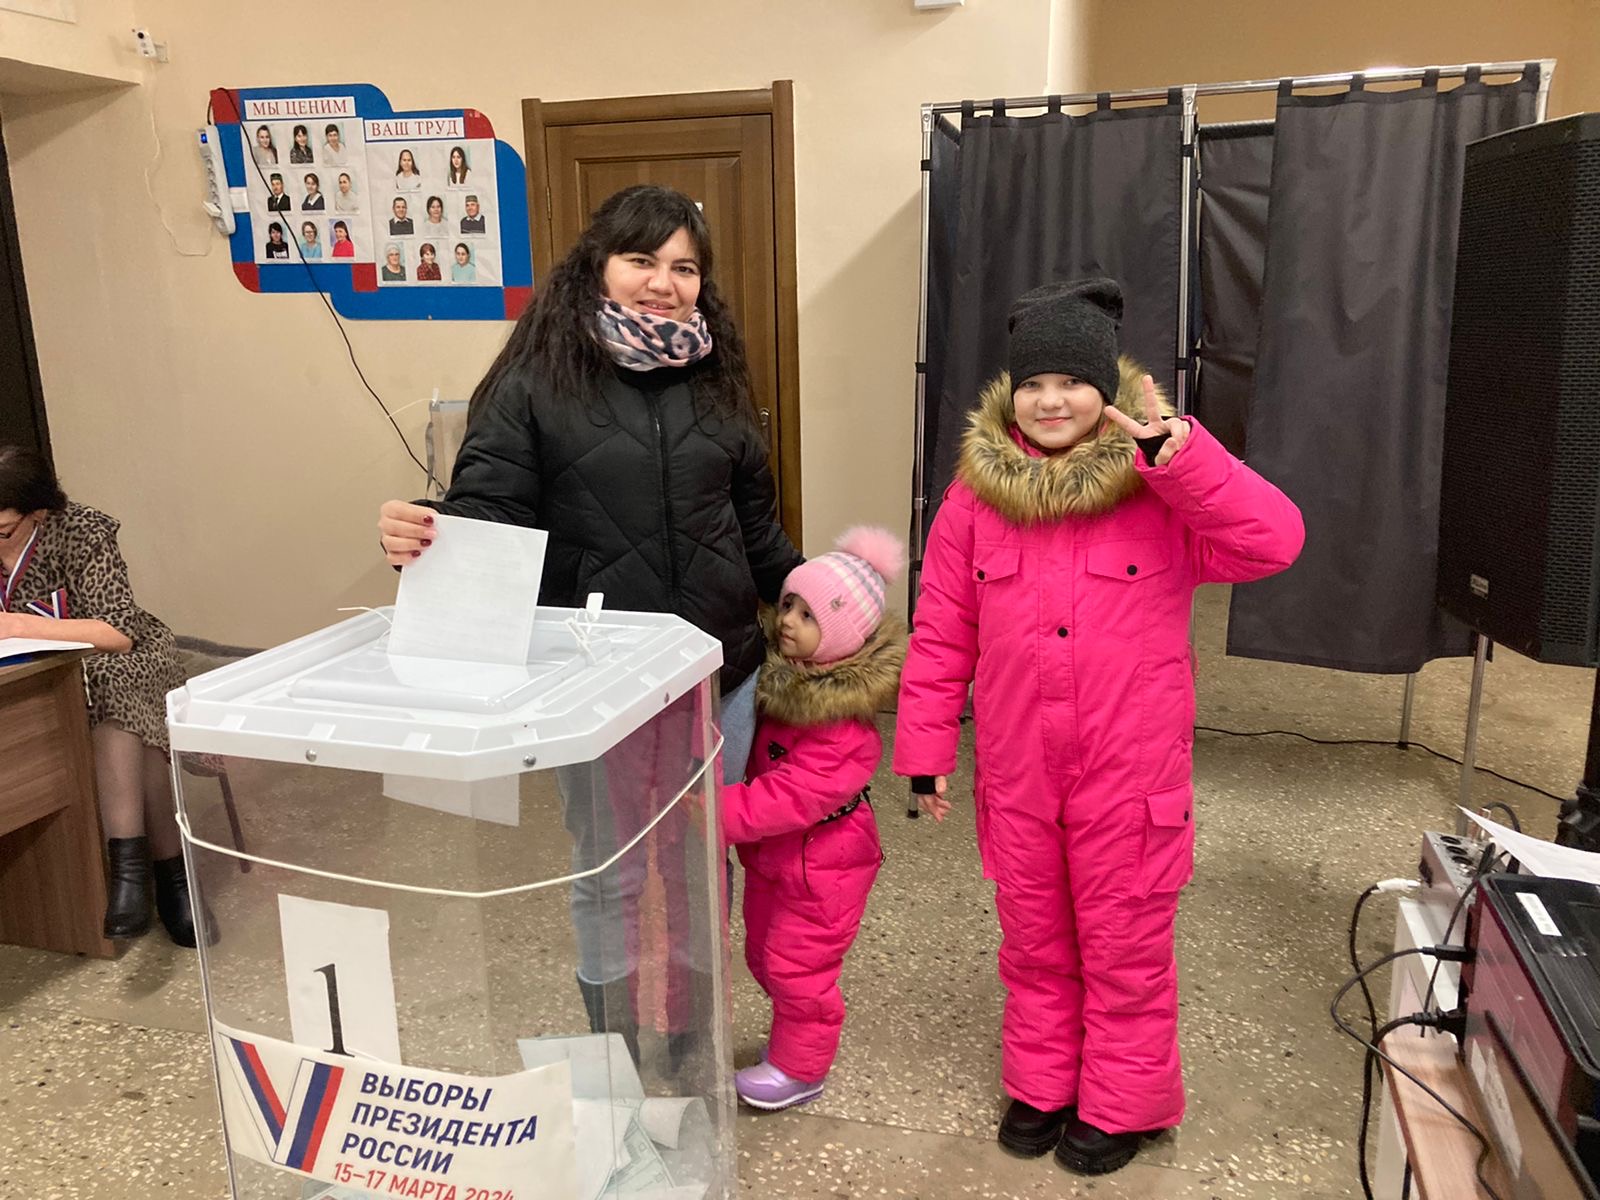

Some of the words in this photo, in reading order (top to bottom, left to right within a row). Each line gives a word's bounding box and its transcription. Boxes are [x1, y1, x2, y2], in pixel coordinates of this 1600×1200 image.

[253, 102, 279, 116] МЫ
[286, 99, 347, 117] ЦЕНИМ
[371, 122, 409, 137] ВАШ
[415, 119, 459, 137] ТРУД
[313, 963, 356, 1057] 1
[360, 1072, 493, 1112] ВЫБОРЫ
[350, 1102, 539, 1148] ПРЕЗИДЕНТА
[340, 1132, 455, 1175] РОССИИ
[388, 1174, 458, 1200] МАРТА
